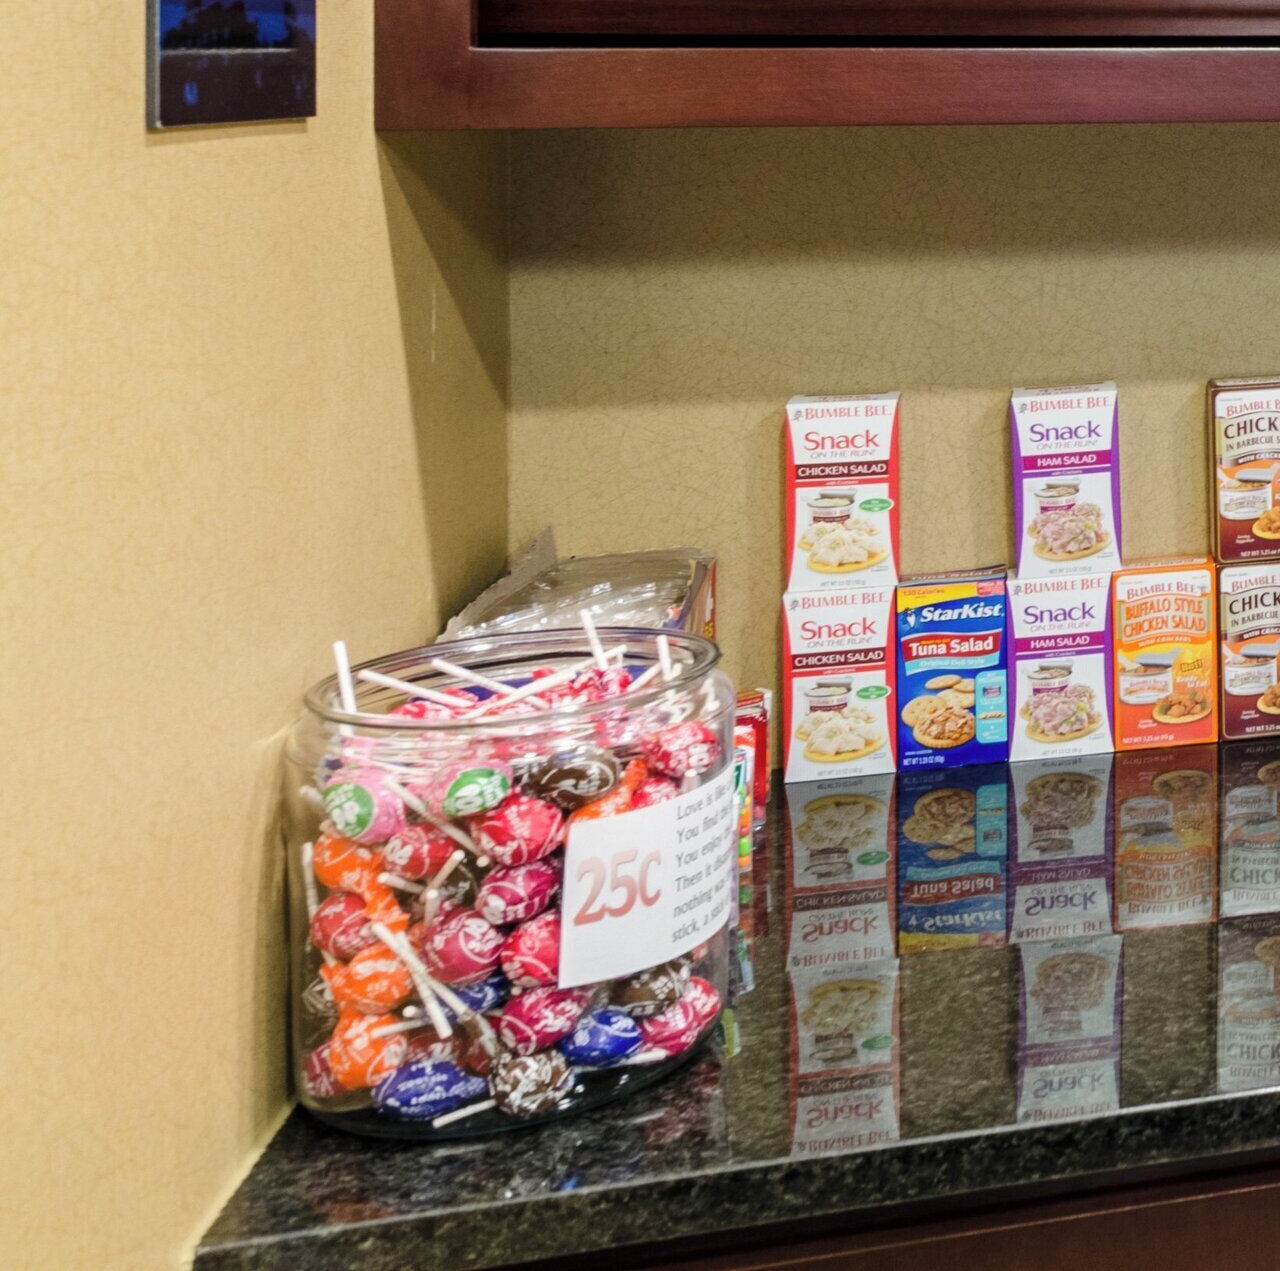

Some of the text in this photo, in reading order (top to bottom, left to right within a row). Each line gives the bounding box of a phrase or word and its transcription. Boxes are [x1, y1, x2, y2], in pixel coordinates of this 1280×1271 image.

[805, 405, 892, 420] BUMBLE BEE
[1030, 397, 1110, 413] BUMBLE BEE
[1226, 401, 1272, 417] BUMBLE
[1029, 420, 1101, 443] Snack
[804, 430, 880, 451] Snack
[1226, 443, 1235, 451] IN
[1236, 437, 1274, 450] BARBECUE
[1037, 455, 1097, 467] HAM SALAD
[798, 465, 887, 477] CHICKEN SALAD
[1024, 578, 1105, 595] BUMBLE BEE
[1127, 581, 1198, 600] BUMBLE BEE
[1231, 577, 1276, 593] BUMBLE
[802, 593, 888, 609] BUMBLE BEE
[920, 603, 1001, 622] StarKist
[1023, 602, 1096, 625] Snack
[1126, 598, 1204, 621] BUFFALO STYLE
[1123, 614, 1206, 638] CHICKEN SALAD
[1231, 618, 1240, 627] IN
[1241, 612, 1279, 625] BARBECUE
[800, 617, 878, 641] Snack
[909, 636, 994, 657] Tuna Salad
[1030, 635, 1090, 649] HAM SALAD
[794, 651, 884, 666] CHICKEN SALAD
[677, 801, 703, 821] Love
[677, 828, 699, 844] You
[676, 853, 698, 869] You
